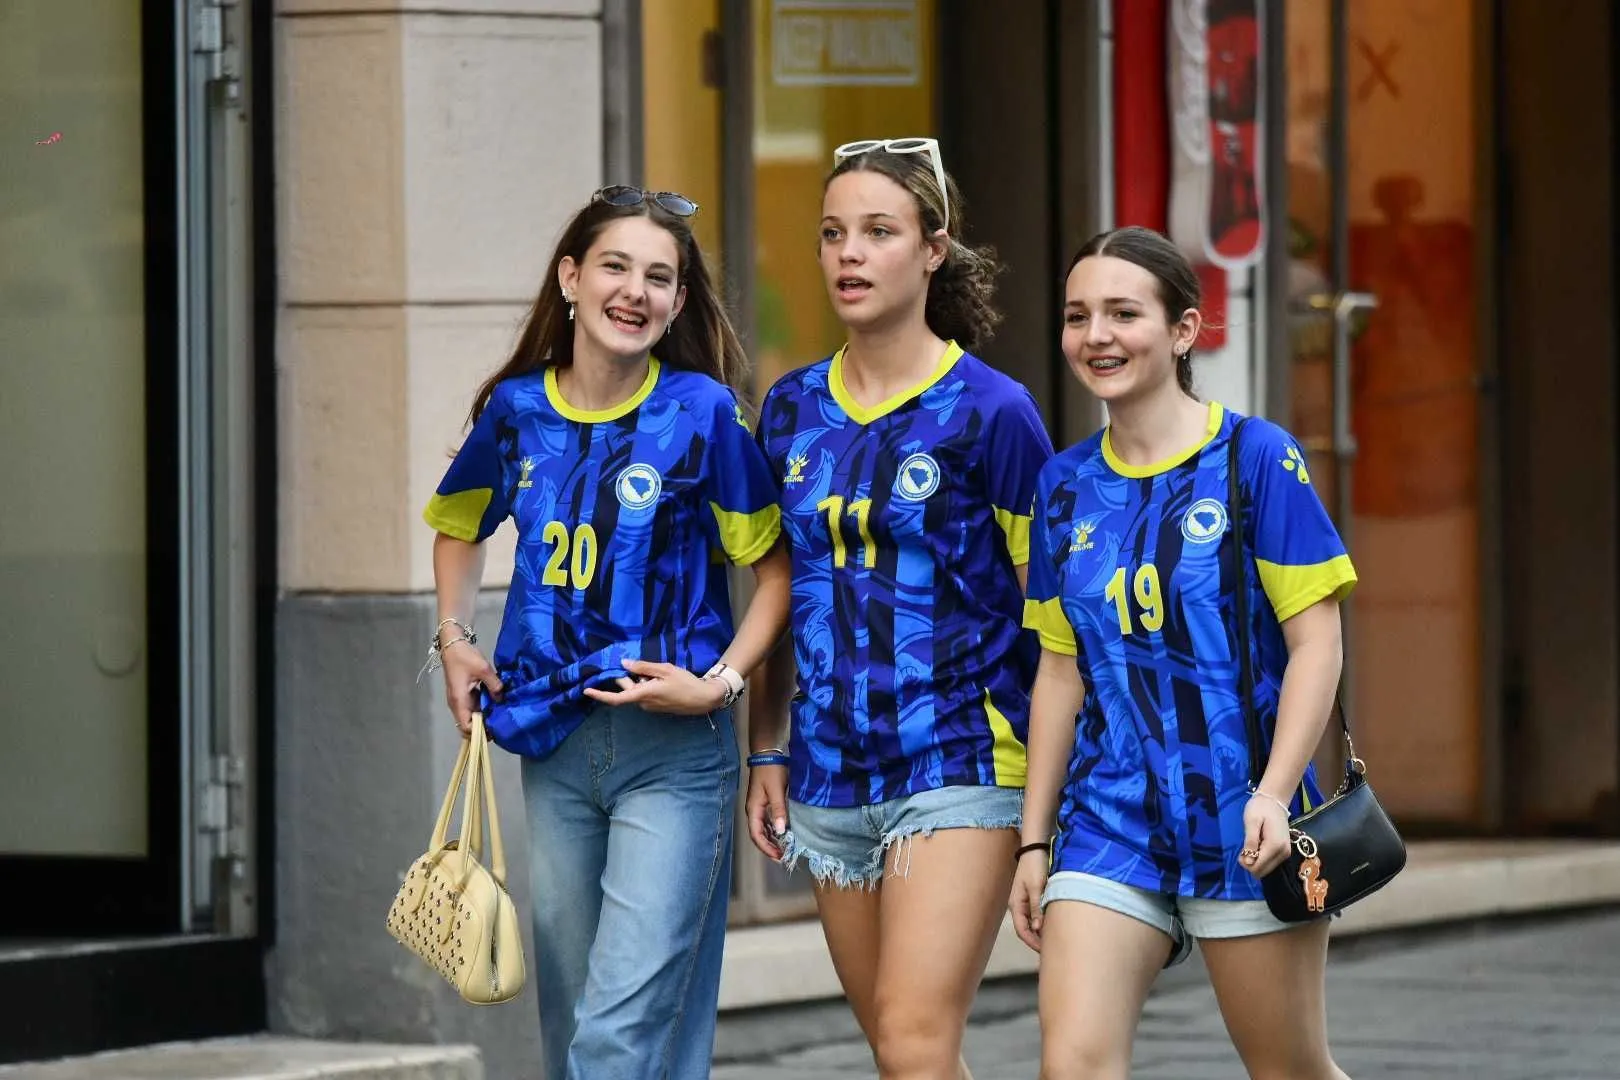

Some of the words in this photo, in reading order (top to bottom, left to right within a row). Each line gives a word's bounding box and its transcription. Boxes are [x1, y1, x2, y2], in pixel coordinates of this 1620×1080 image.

[542, 520, 598, 590] 20
[817, 495, 876, 568] 11
[1105, 563, 1164, 635] 19
